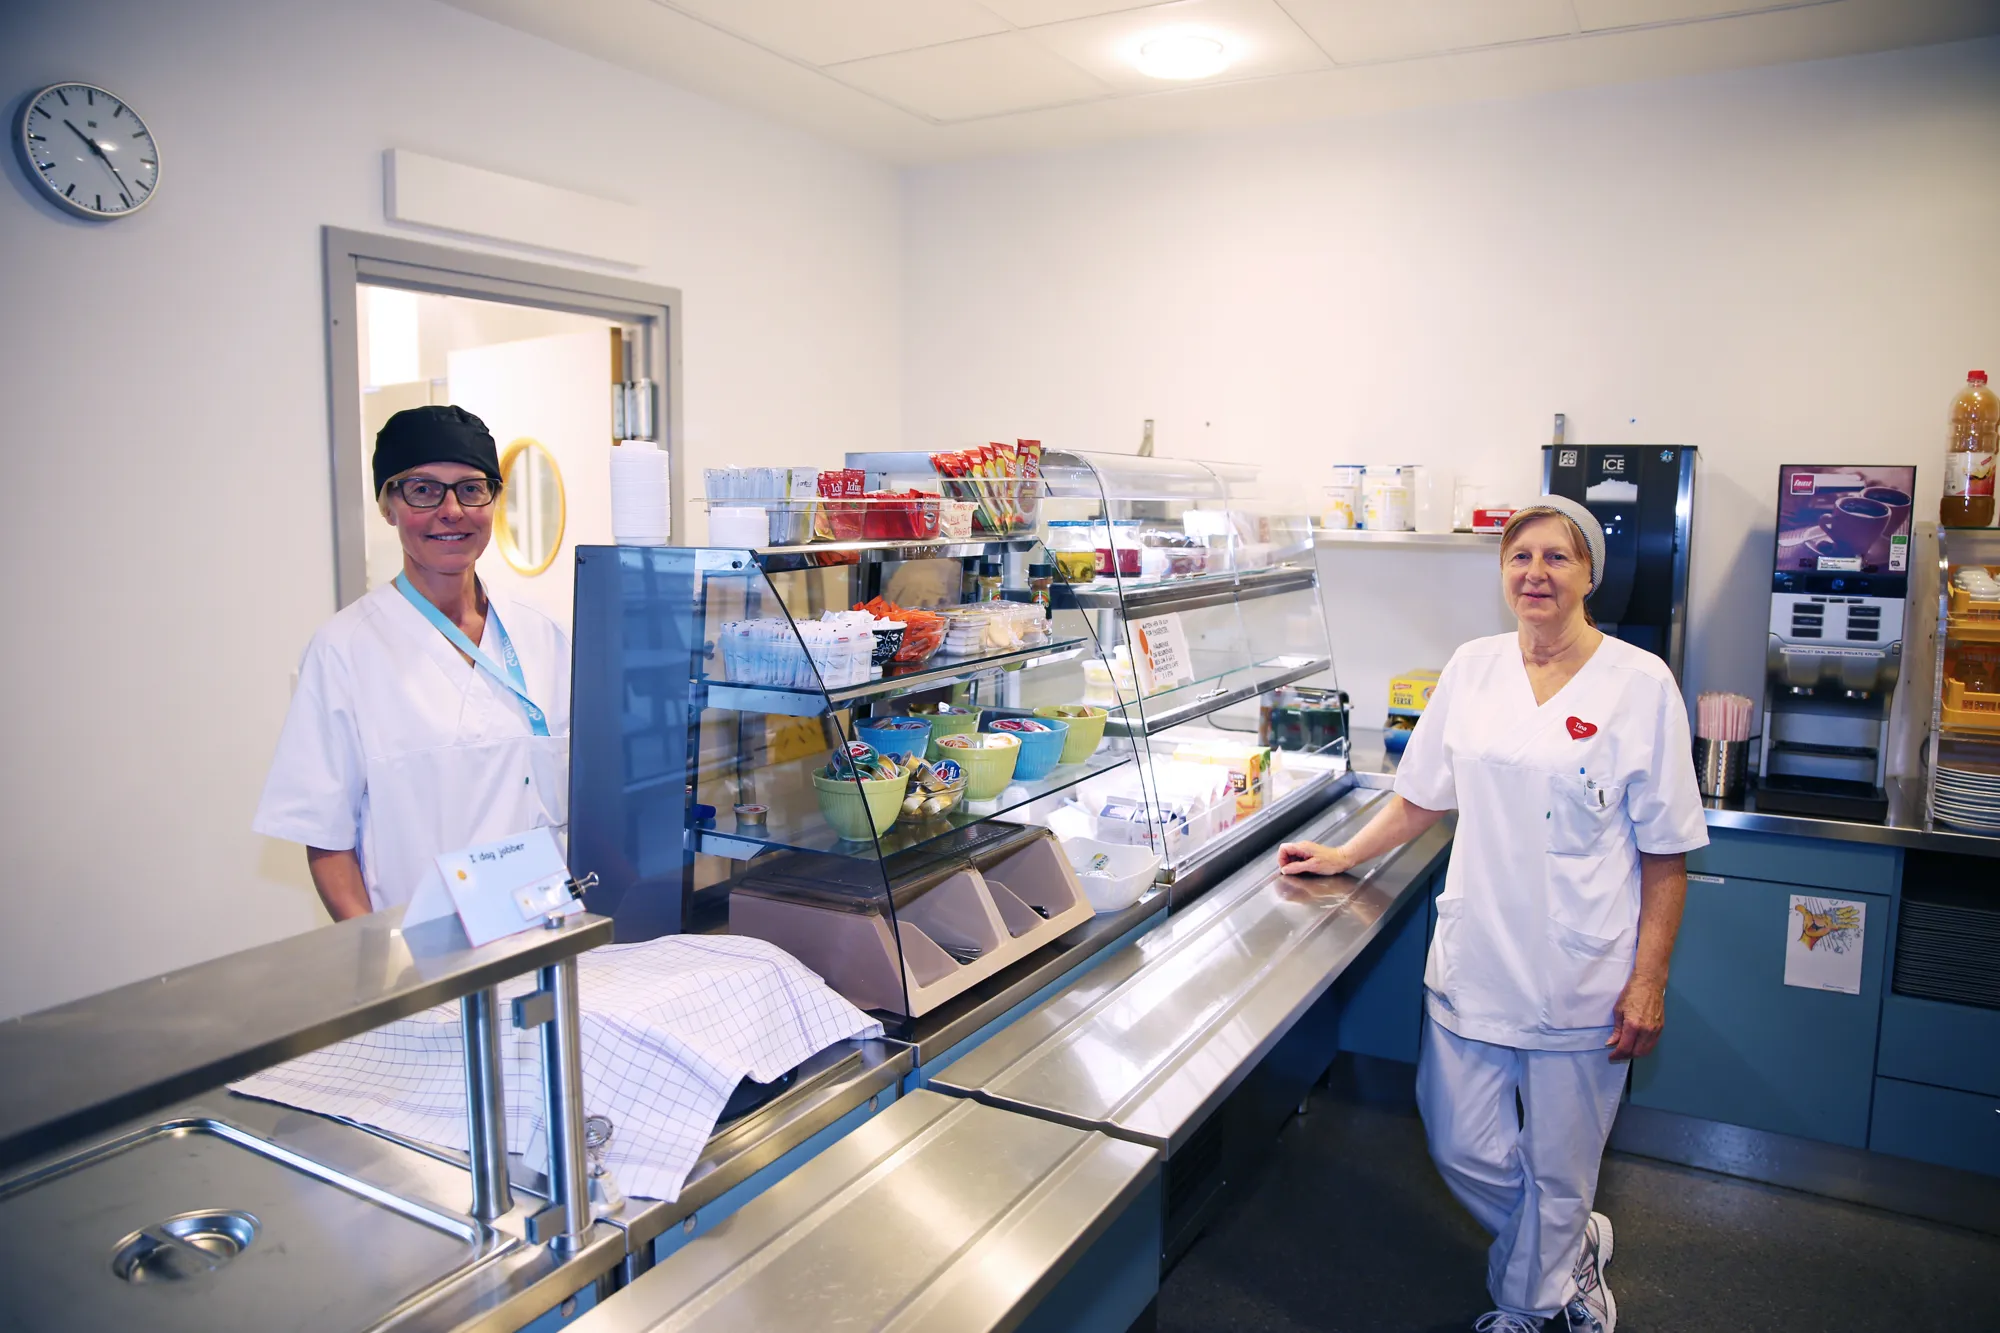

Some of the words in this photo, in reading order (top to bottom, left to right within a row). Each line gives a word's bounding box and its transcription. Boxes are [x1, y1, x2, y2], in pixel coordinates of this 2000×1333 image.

[1602, 459, 1625, 470] ICE
[1575, 722, 1588, 732] Tina
[469, 854, 476, 864] I
[479, 851, 496, 861] dag
[497, 843, 525, 858] jobber
